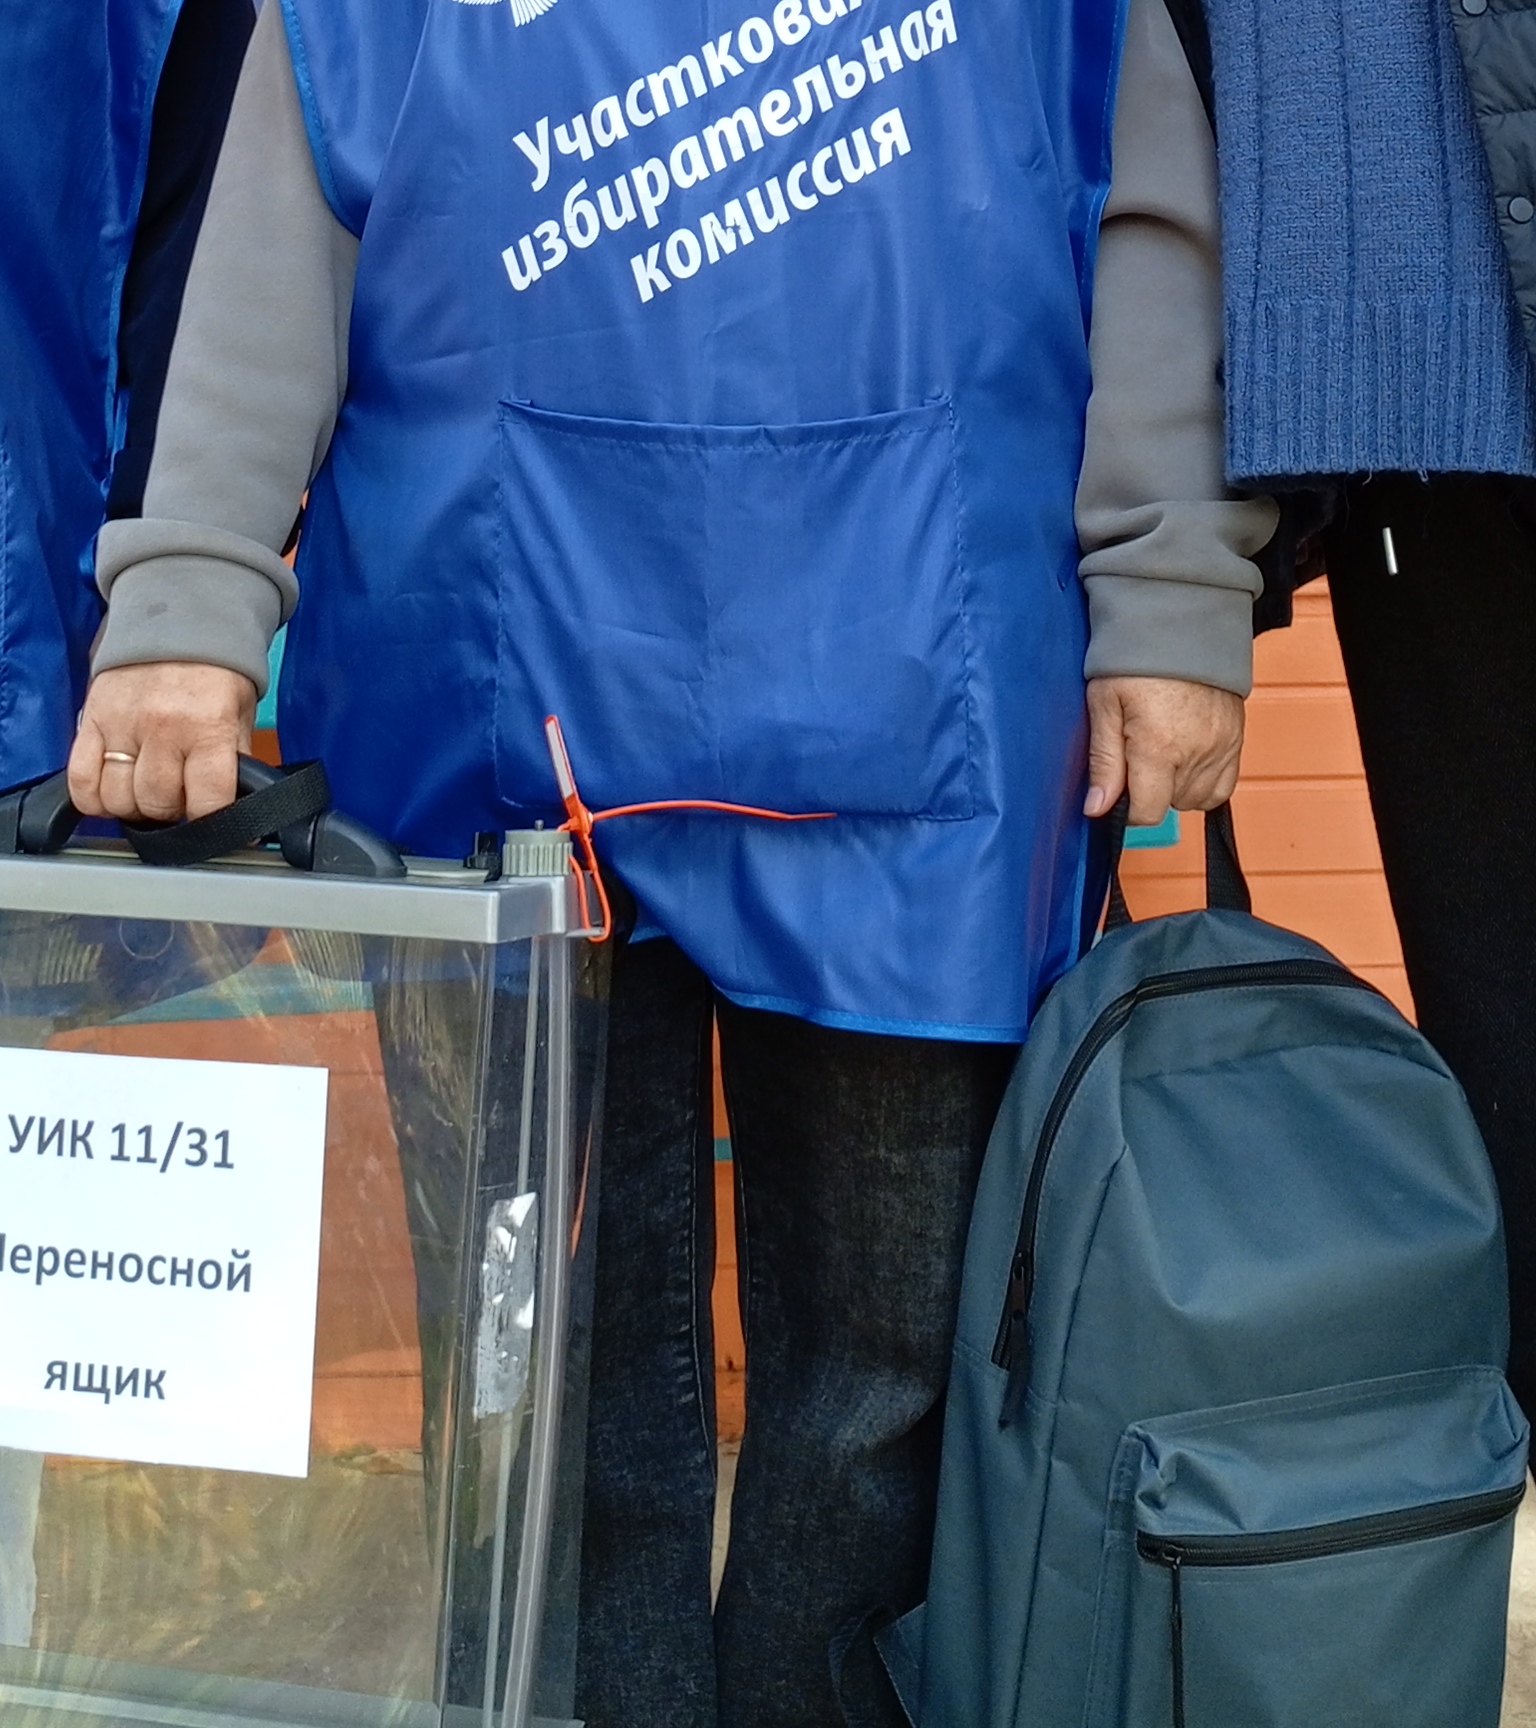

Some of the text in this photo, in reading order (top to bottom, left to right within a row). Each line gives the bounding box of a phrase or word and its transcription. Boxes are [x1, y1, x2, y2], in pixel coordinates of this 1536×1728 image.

[629, 106, 912, 304] комиссия
[8, 1114, 235, 1174] УИК 11/31
[43, 1360, 167, 1405] ящик
